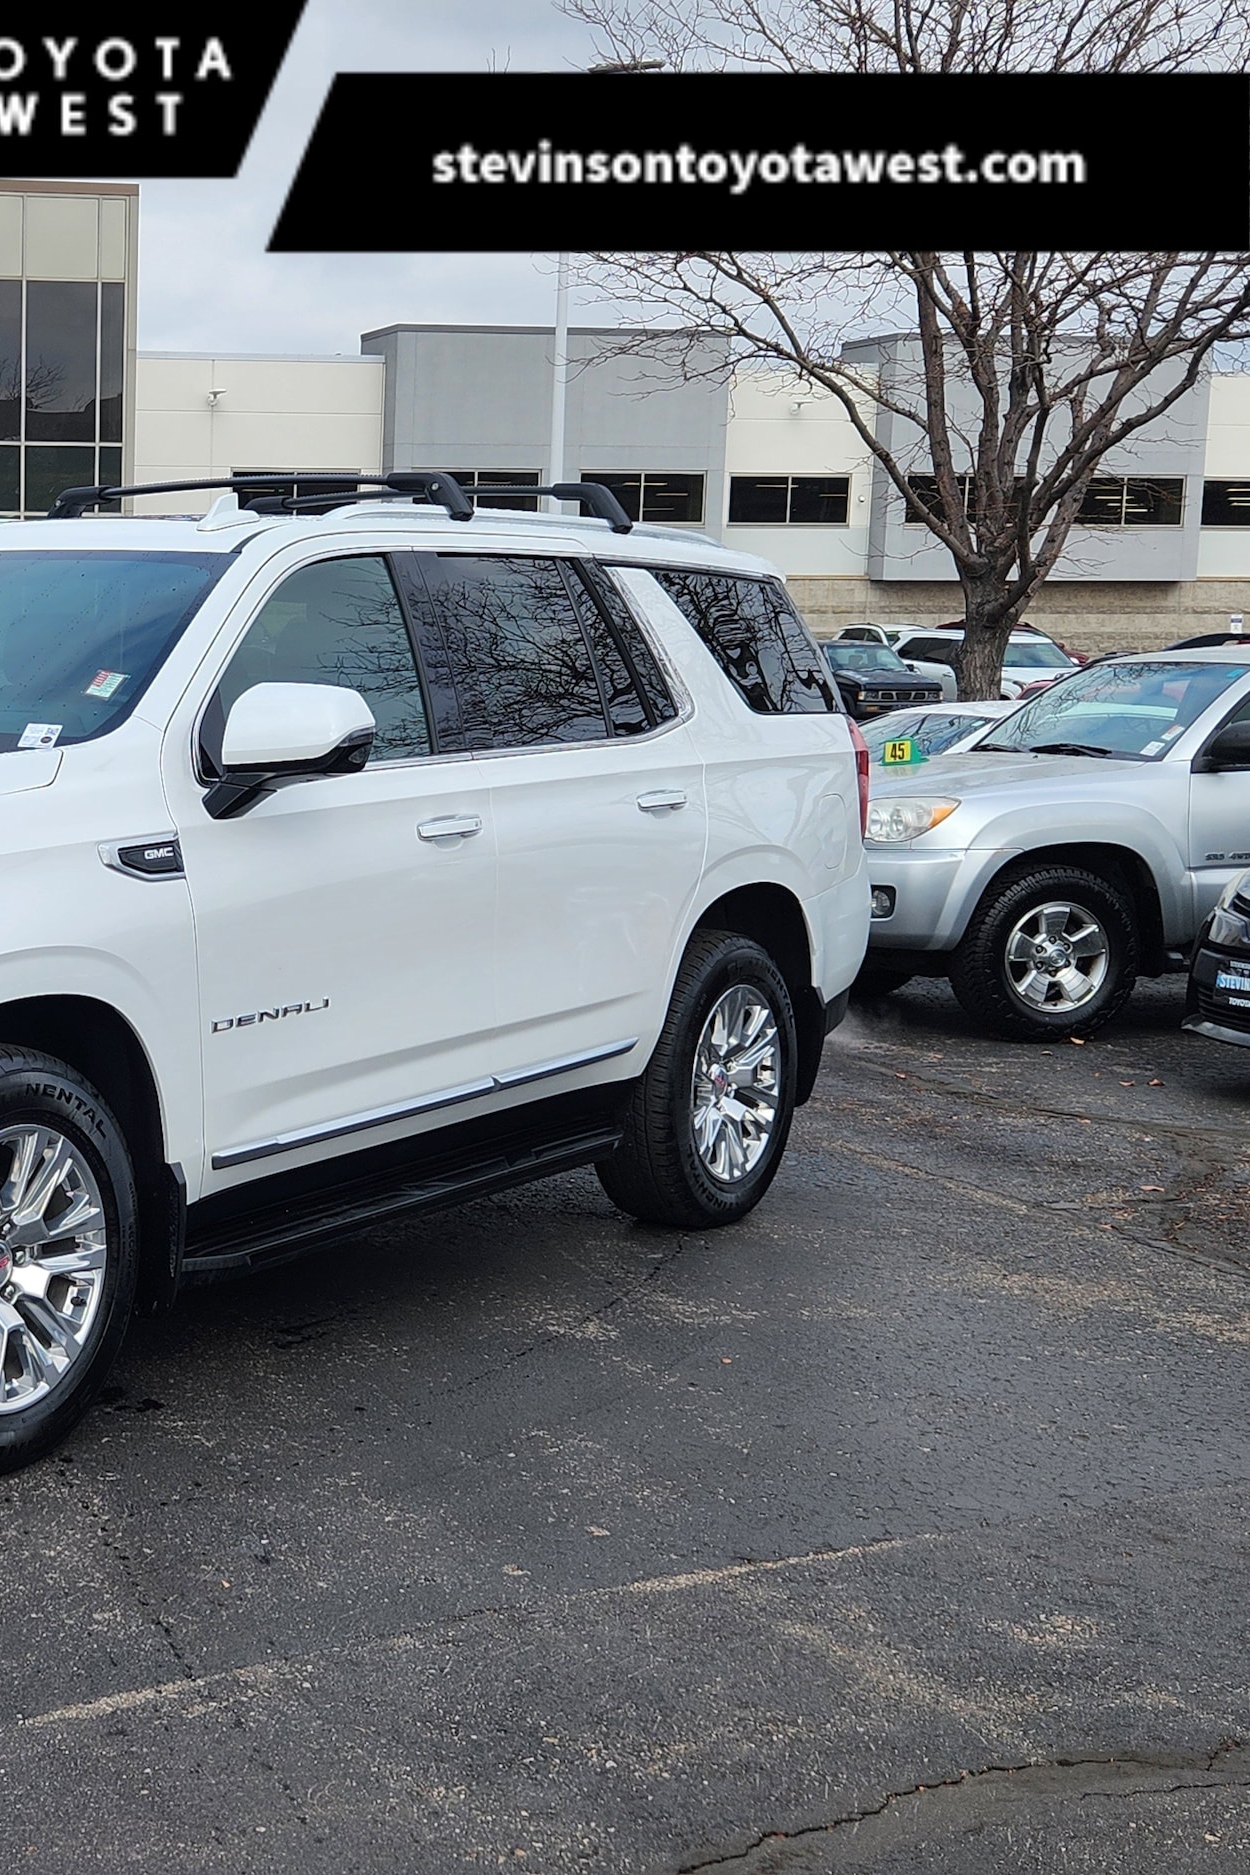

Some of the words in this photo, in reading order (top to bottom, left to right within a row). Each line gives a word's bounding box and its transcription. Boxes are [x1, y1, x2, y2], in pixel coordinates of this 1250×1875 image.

[890, 742, 905, 761] 45
[144, 846, 174, 860] GMC
[211, 997, 330, 1034] DENALI
